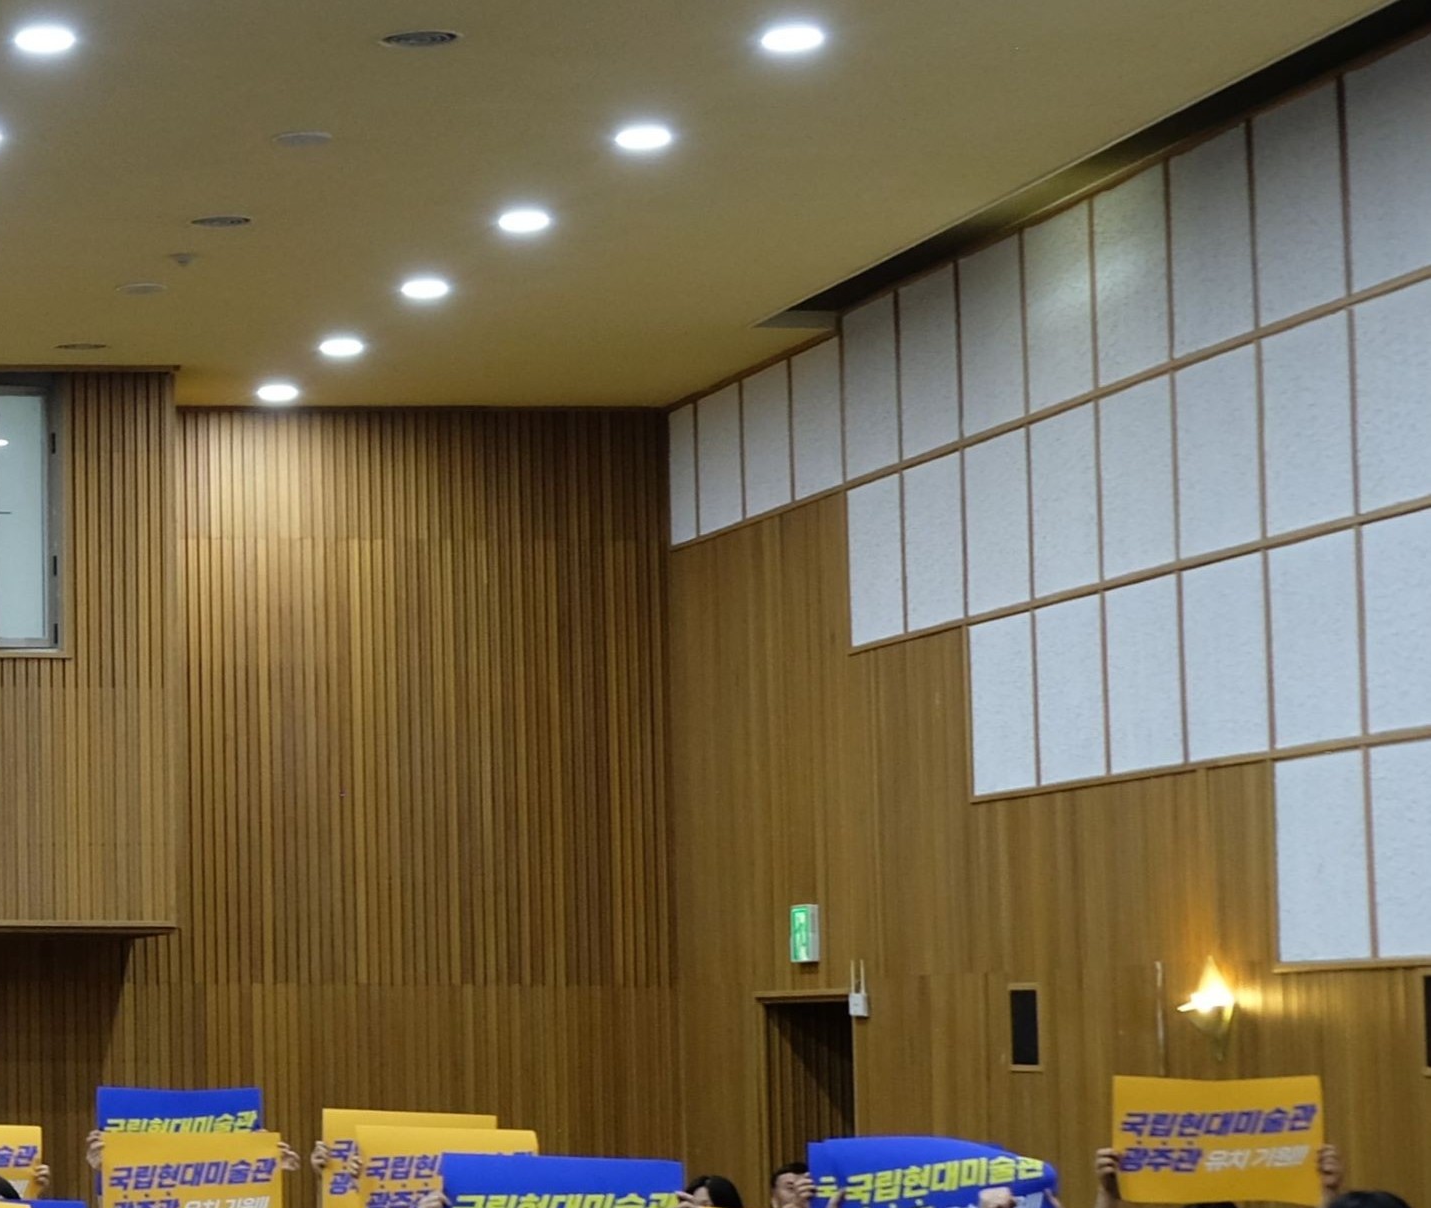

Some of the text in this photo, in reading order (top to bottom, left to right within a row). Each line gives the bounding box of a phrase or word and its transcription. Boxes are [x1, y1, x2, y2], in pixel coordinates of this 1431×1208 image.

[1120, 1104, 1318, 1137] 국립현대미술관
[109, 1158, 276, 1190] 국립현대미술관
[1118, 1146, 1309, 1172] 광주관 유치 기원!!
[845, 1155, 1045, 1203] 국립현대미술관
